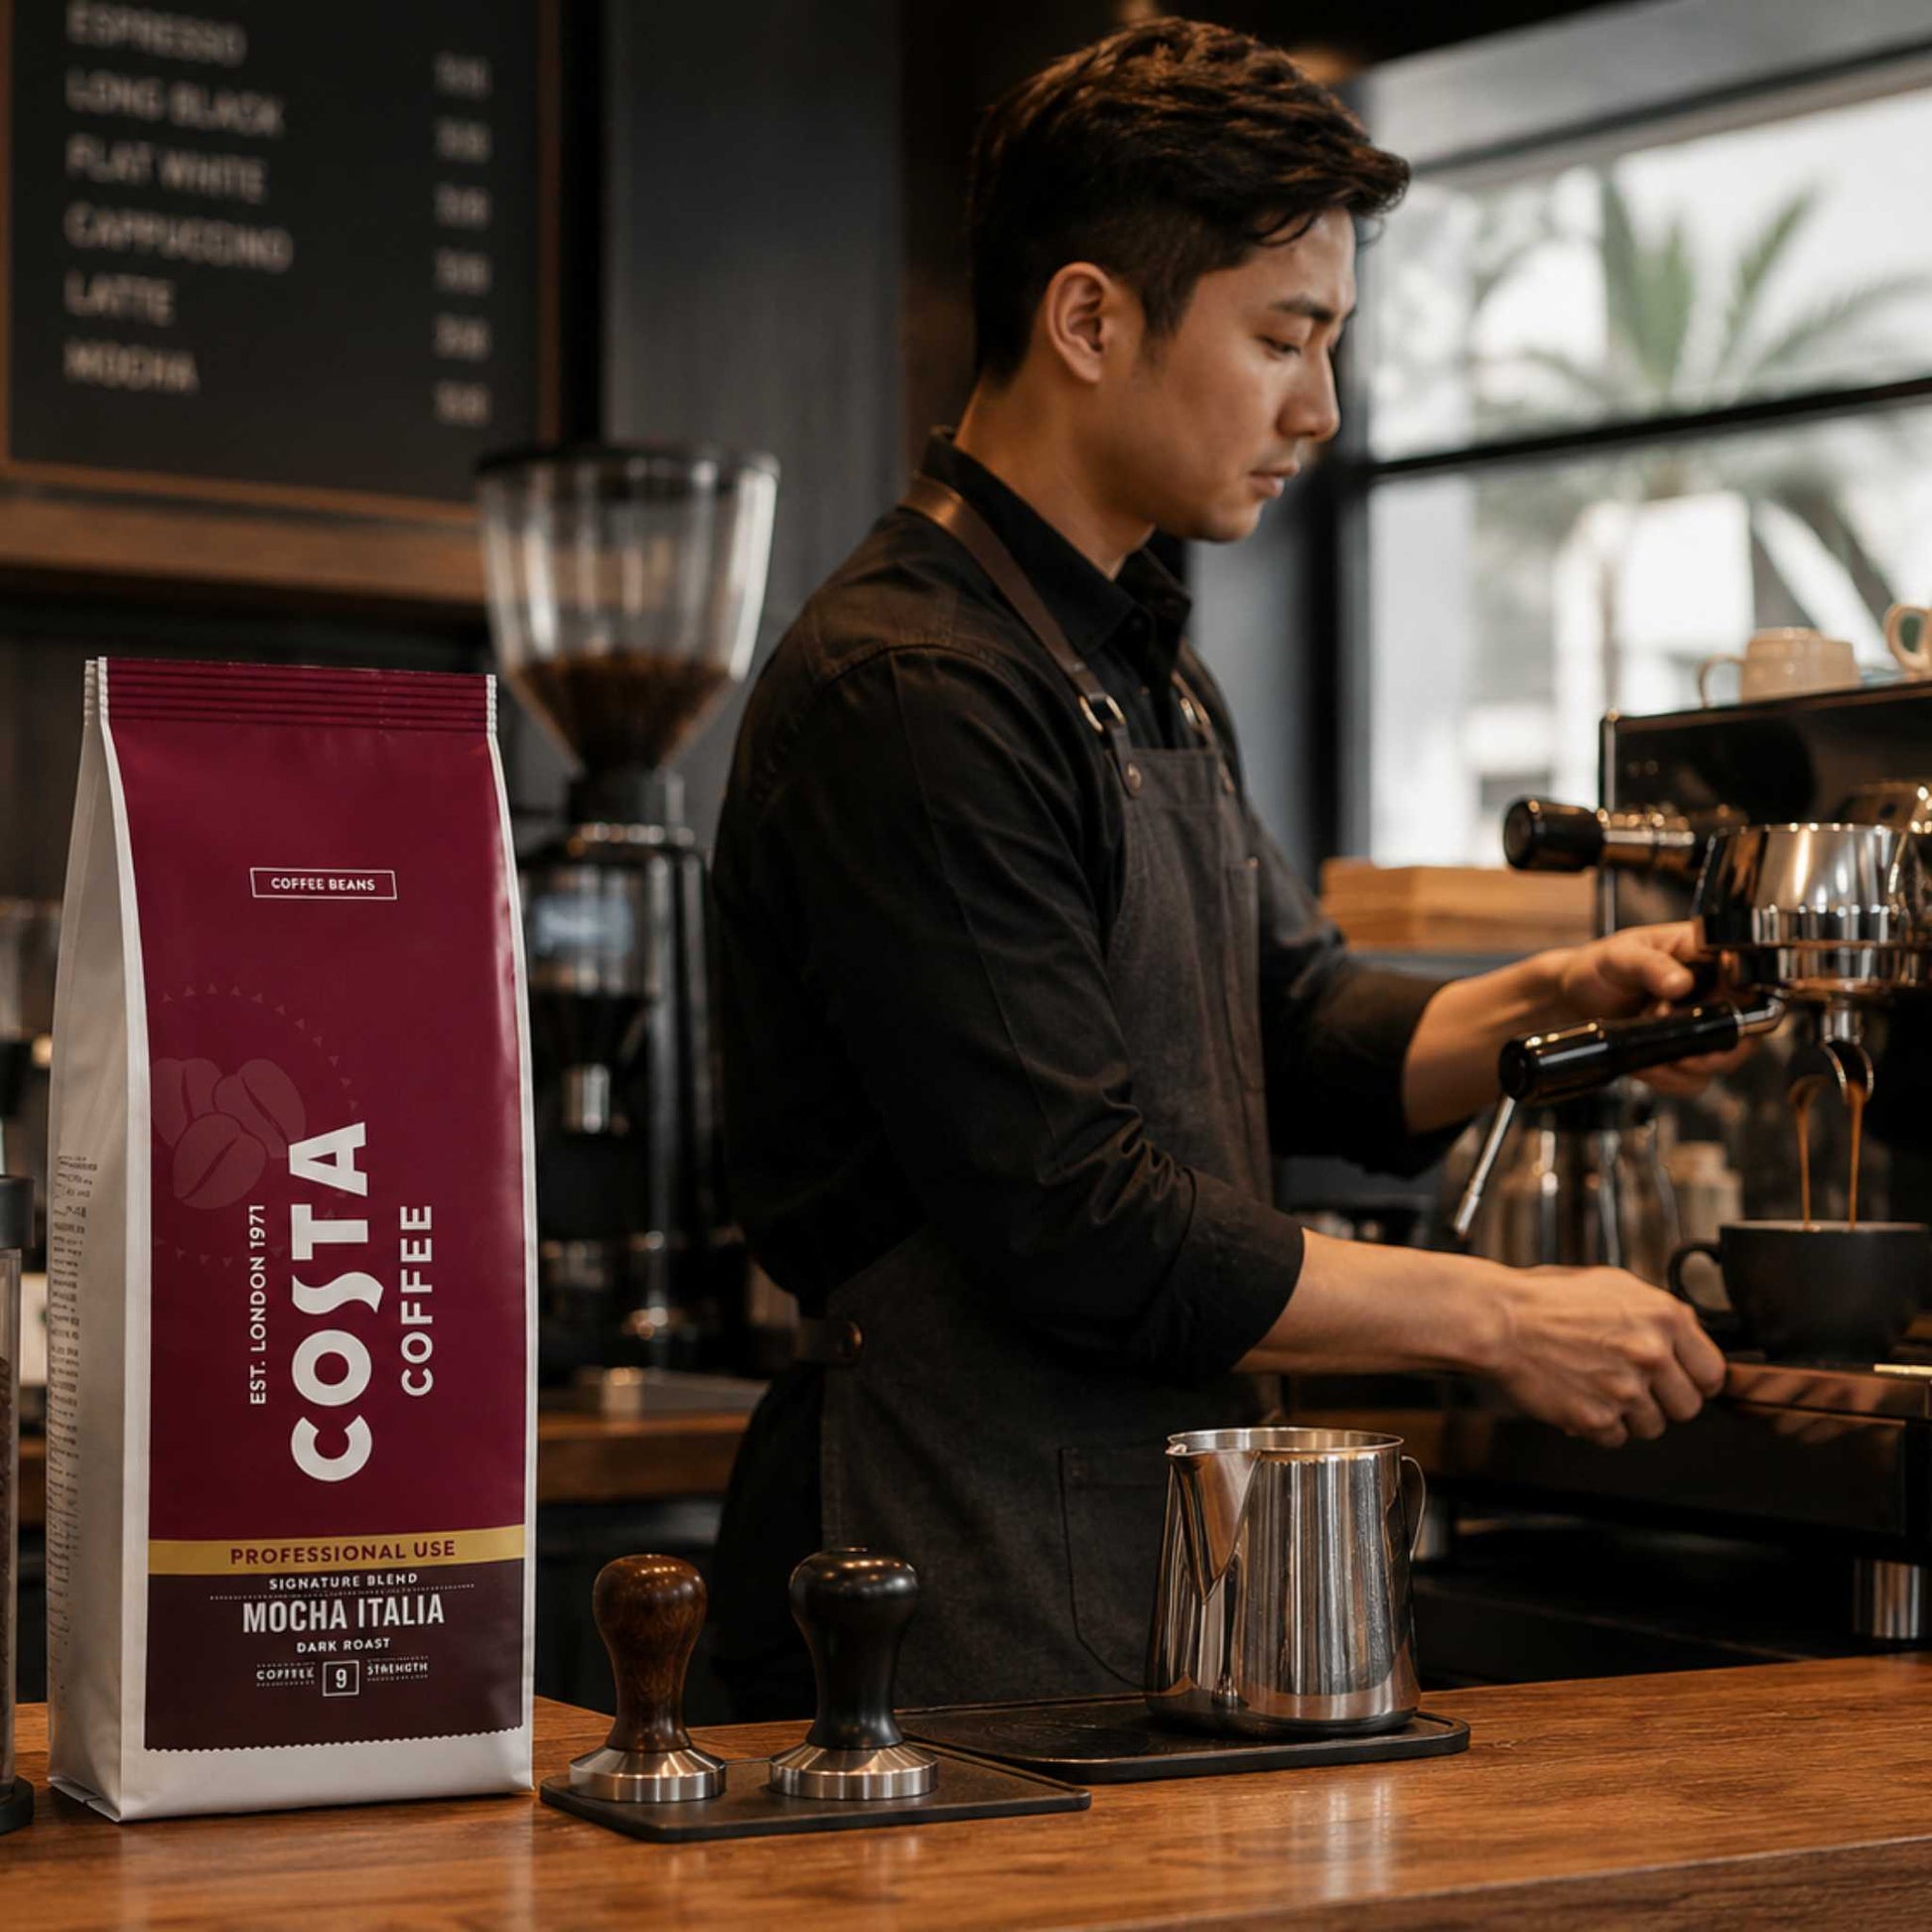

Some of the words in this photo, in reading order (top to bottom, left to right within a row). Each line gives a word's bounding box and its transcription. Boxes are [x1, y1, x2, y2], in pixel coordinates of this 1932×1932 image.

[67, 69, 165, 120] LONG
[168, 82, 284, 137] BLACK
[67, 134, 153, 185] FLAT
[158, 148, 266, 204] WHITE
[65, 272, 174, 326] LATTE
[64, 340, 198, 393] MOCHA
[271, 878, 326, 890] COFFEE
[329, 879, 375, 891] BEANS
[248, 1205, 265, 1249] 1971
[249, 1257, 266, 1352] LONDON
[289, 1123, 384, 1482] COSTA
[400, 1206, 434, 1396] COFFEE
[250, 1361, 266, 1405] EST.
[230, 1545, 406, 1565] PROFESSIONAL
[413, 1540, 456, 1558] USE
[269, 1576, 360, 1589] SIGNATURE
[367, 1573, 418, 1587] BLEND
[243, 1599, 347, 1633] MOCHA
[358, 1594, 445, 1628] ITALIA
[297, 1641, 338, 1654] DARK
[344, 1638, 390, 1651] ROAST
[336, 1669, 347, 1689] 9
